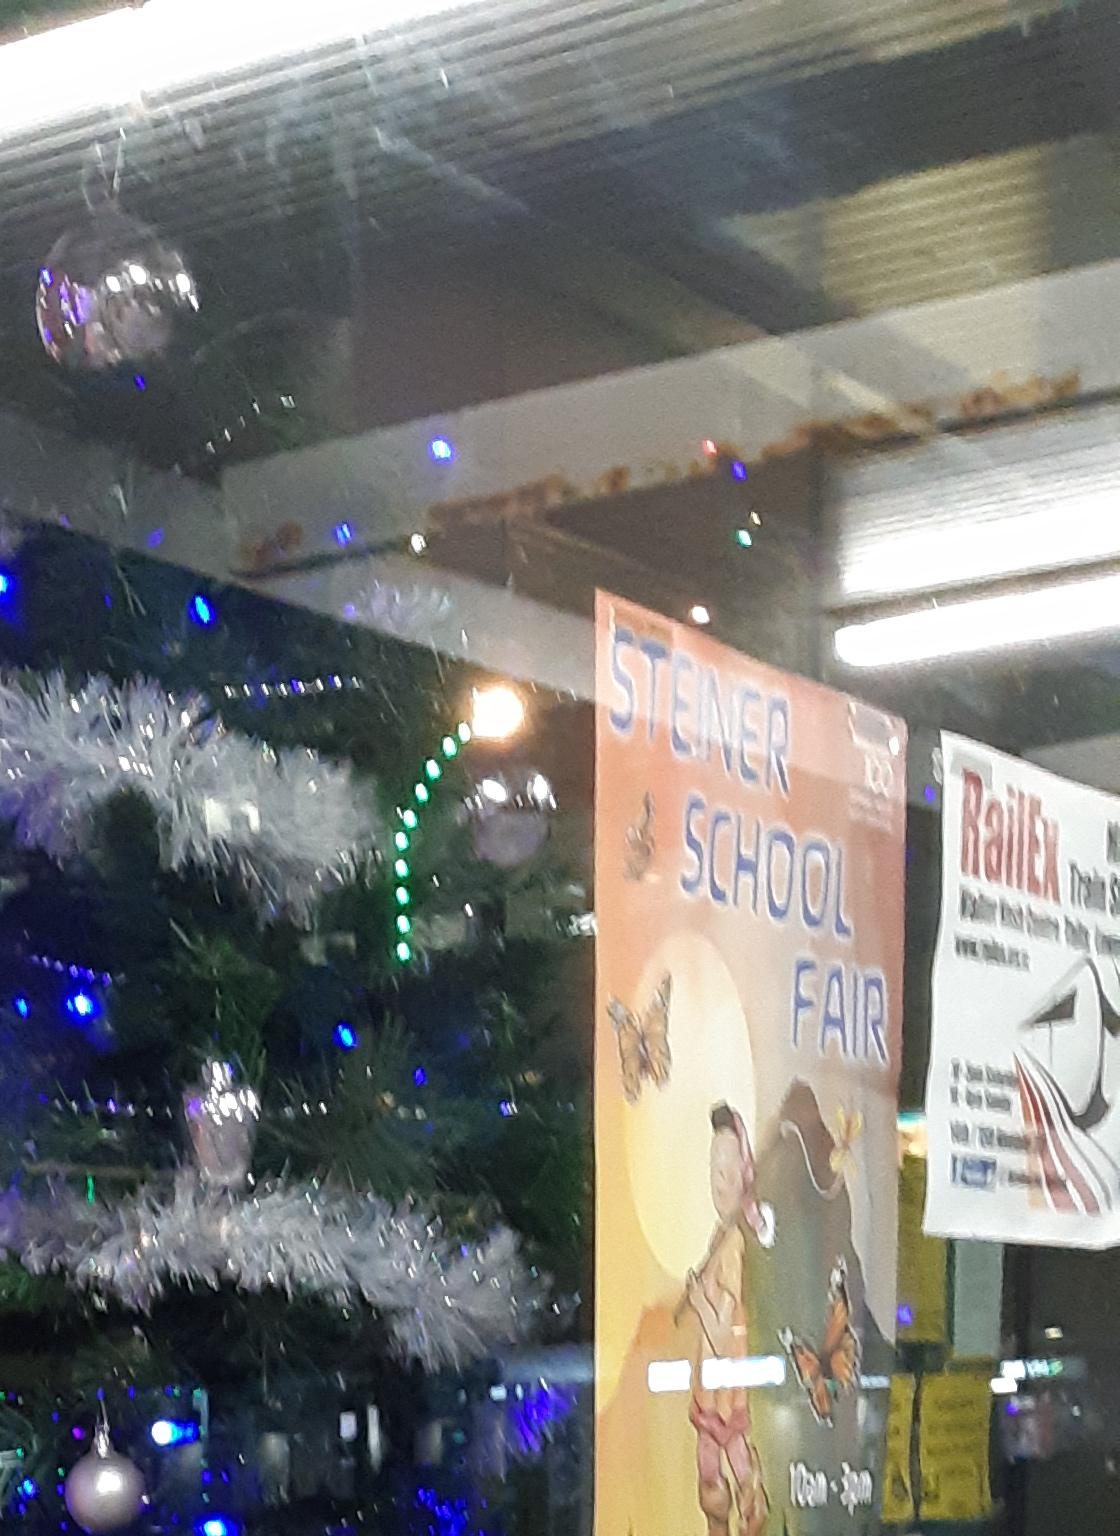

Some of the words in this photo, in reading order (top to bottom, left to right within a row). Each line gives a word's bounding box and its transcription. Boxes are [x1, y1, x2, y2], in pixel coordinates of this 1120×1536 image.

[609, 628, 790, 797] STEINER
[679, 795, 852, 939] SCHOOL
[960, 766, 1061, 905] RailEx
[792, 958, 888, 1063] FAIR
[789, 1462, 828, 1507] 10am
